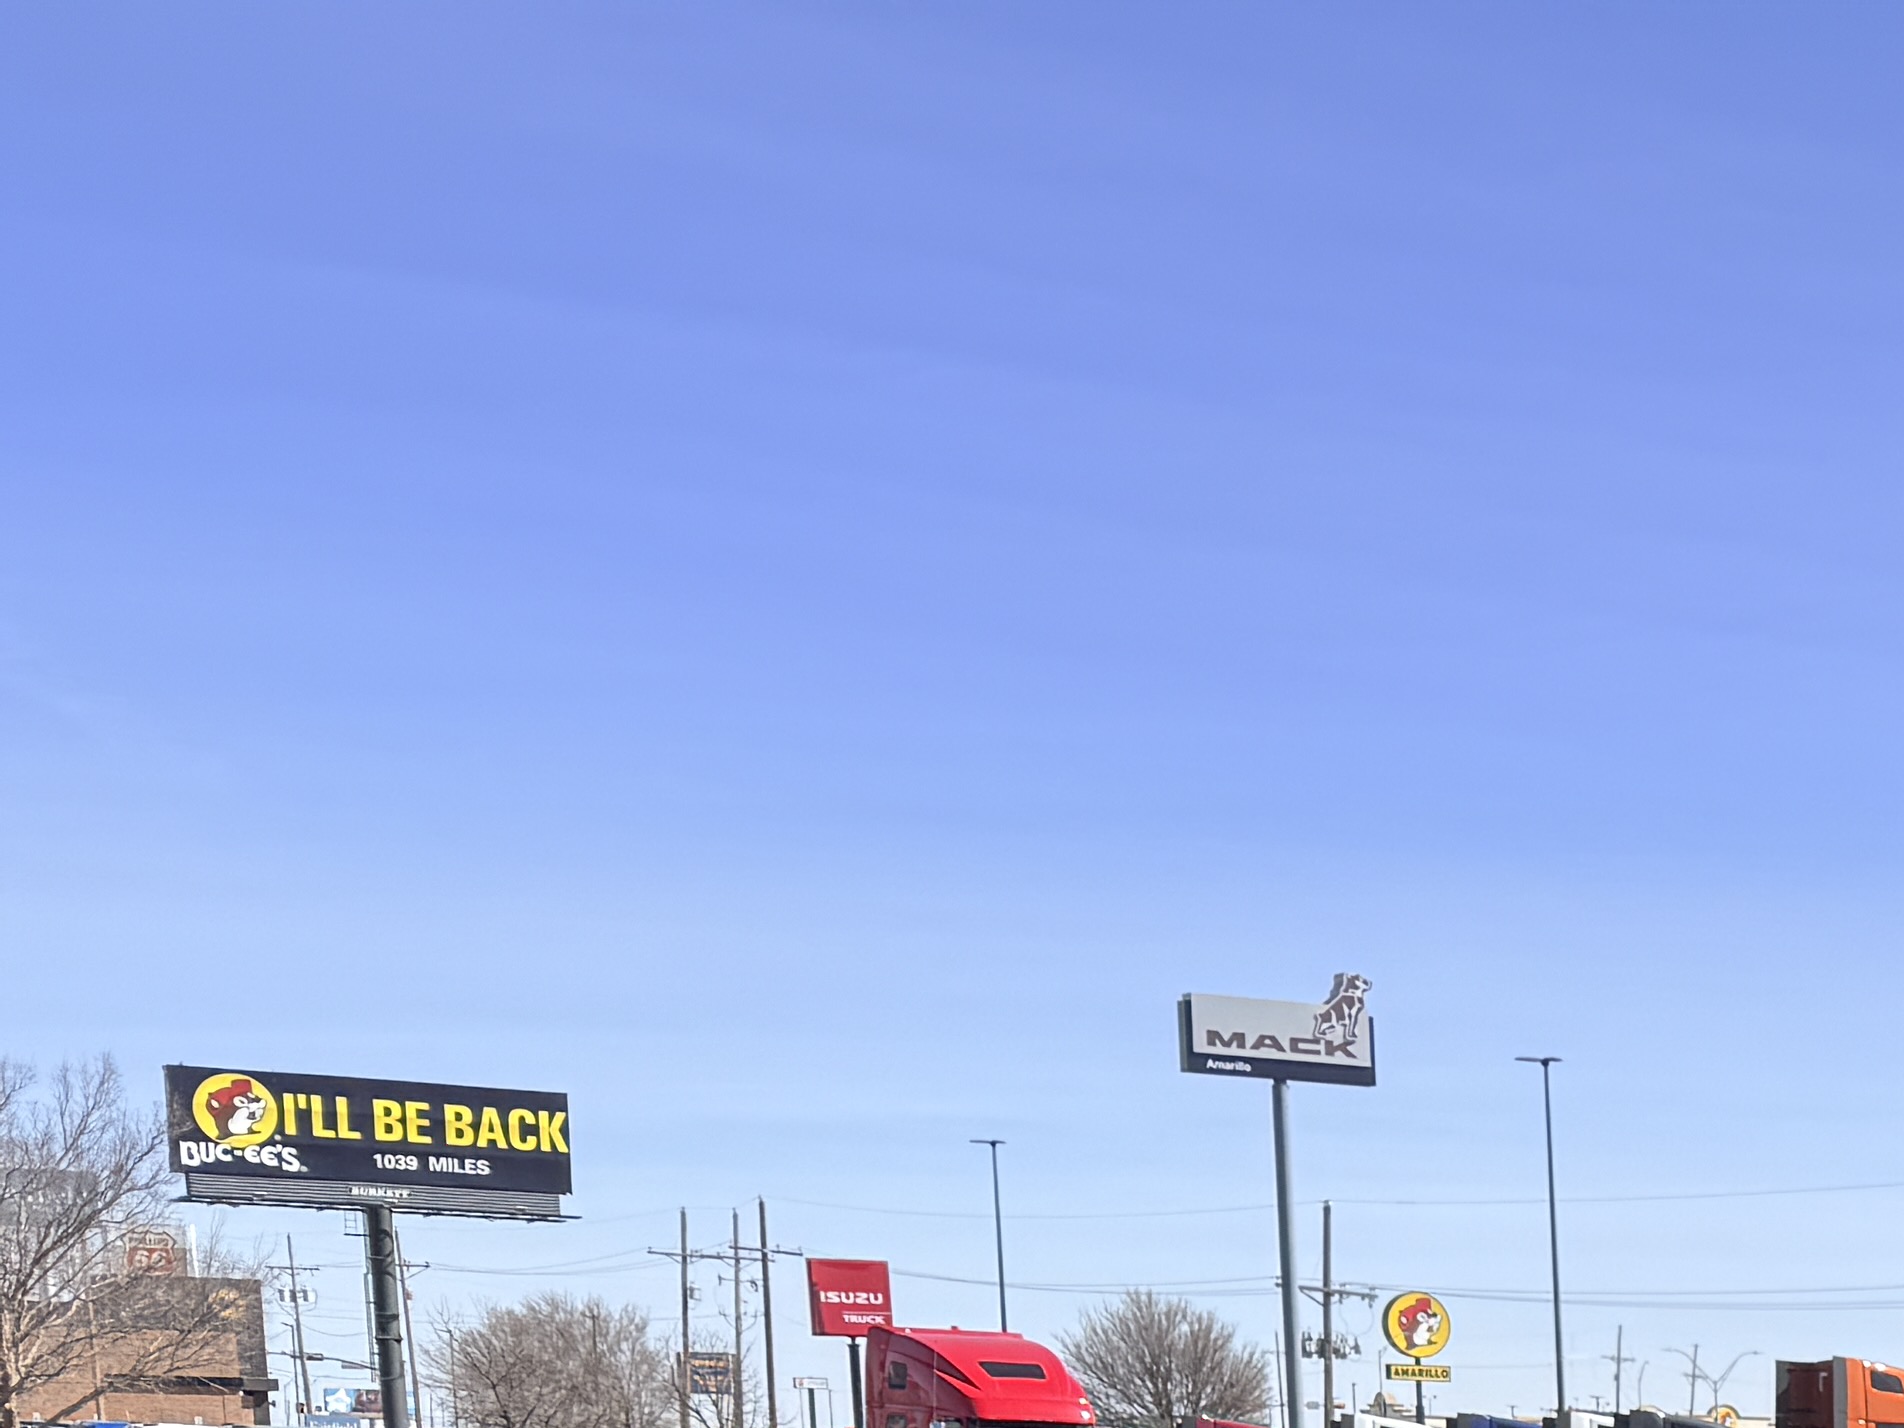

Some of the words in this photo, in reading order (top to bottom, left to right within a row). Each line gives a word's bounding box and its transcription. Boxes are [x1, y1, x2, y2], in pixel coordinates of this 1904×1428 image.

[1206, 1028, 1358, 1060] MACK
[1206, 1058, 1252, 1073] Amarillo
[282, 1092, 362, 1140] I'LL
[372, 1098, 433, 1145] BE
[443, 1103, 569, 1154] BACK
[373, 1153, 419, 1172] 1039
[428, 1155, 492, 1176] MILES
[819, 1290, 884, 1305] ISUZU
[842, 1314, 887, 1325] TRUCK
[1393, 1367, 1449, 1379] AMARILLO
